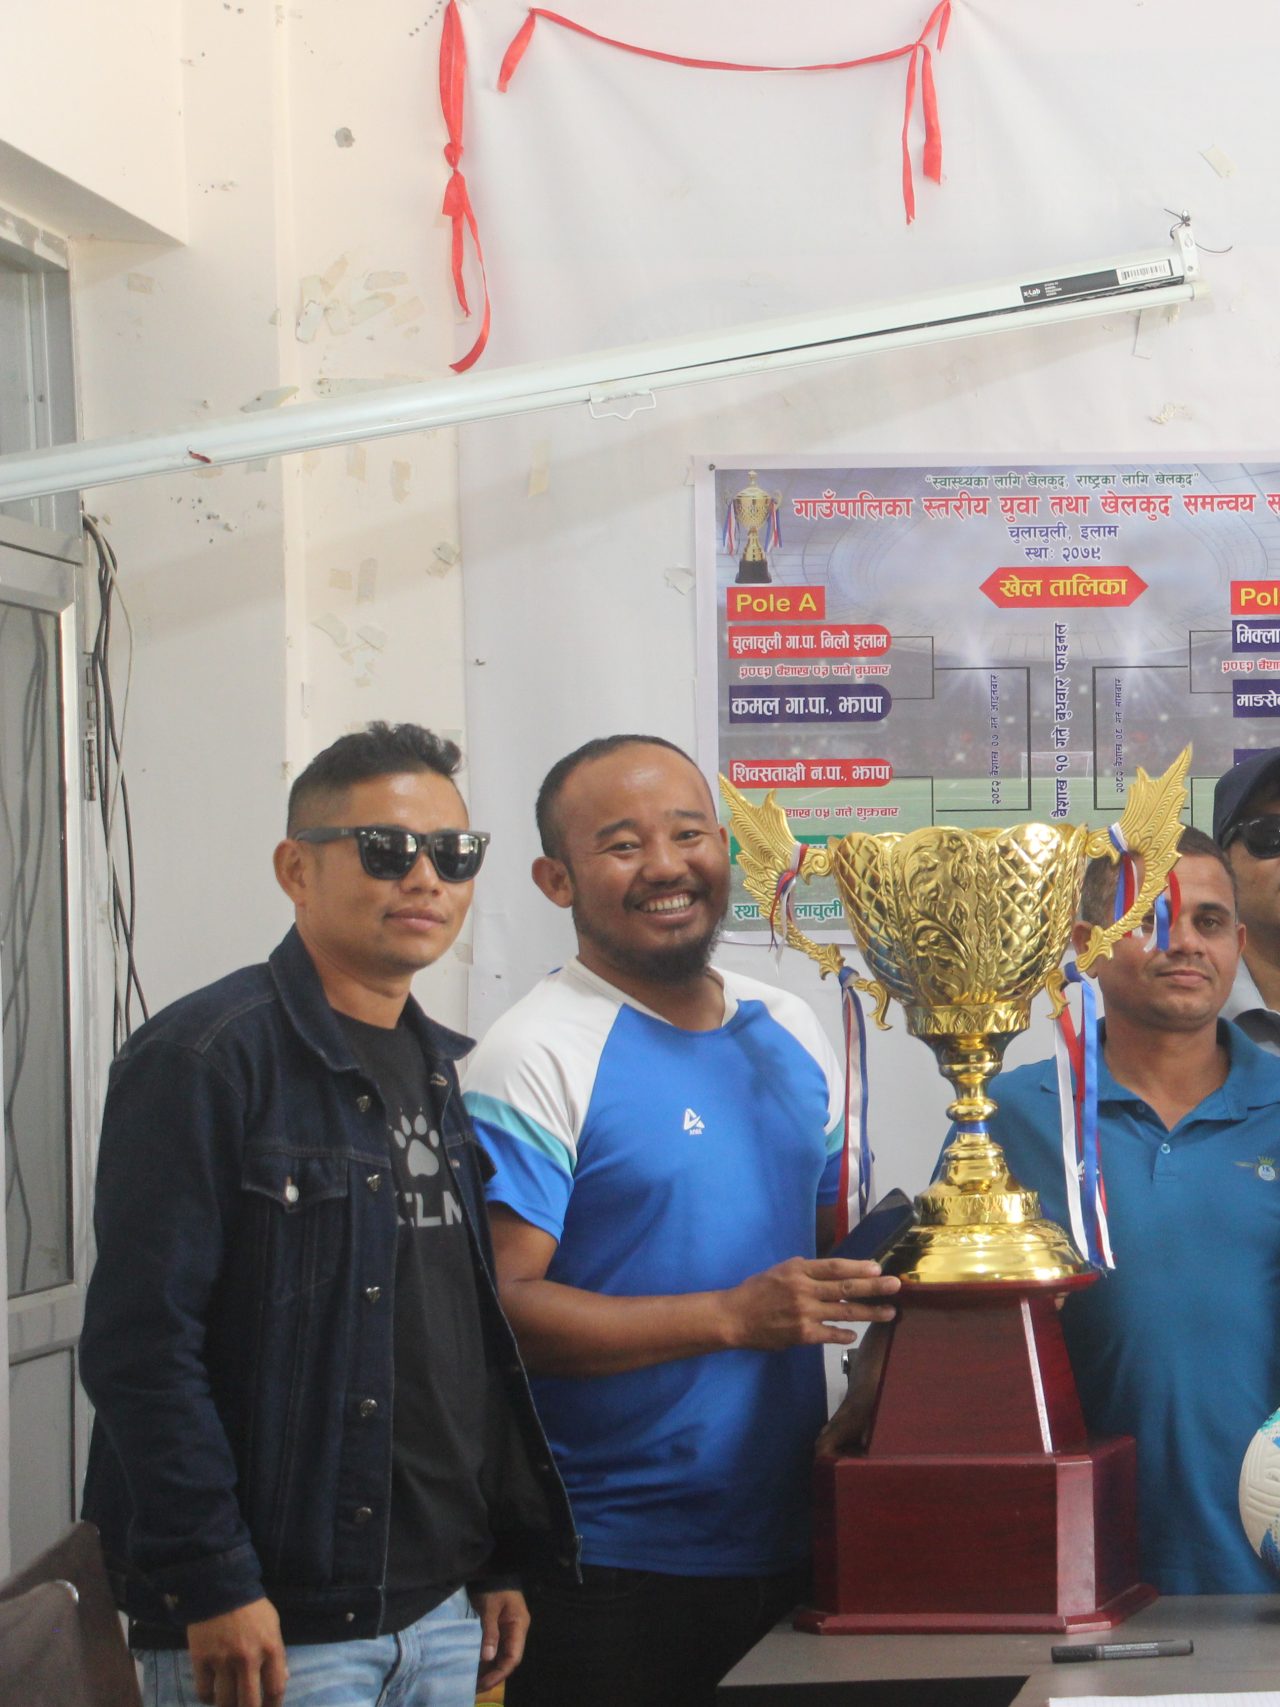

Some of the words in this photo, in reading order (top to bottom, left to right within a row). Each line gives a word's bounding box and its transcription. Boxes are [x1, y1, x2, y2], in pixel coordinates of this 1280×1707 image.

[995, 472, 1021, 488] लागि
[1122, 471, 1149, 487] लागि
[793, 489, 913, 519] गाउँपालिका
[923, 491, 990, 520] स्तरीय
[1000, 496, 1039, 522] युवा
[1050, 495, 1089, 517] तथा
[1101, 491, 1172, 521] खेलकुद
[1183, 494, 1257, 513] समन्वय
[1080, 524, 1119, 541] इलाम
[1063, 546, 1102, 561] २०७९
[1000, 574, 1042, 598] खेल
[1050, 573, 1127, 597] तालिका
[736, 594, 791, 613] Pole
[799, 593, 817, 612] A
[733, 632, 782, 654] चुलाचुली
[854, 634, 887, 651] इलाम
[1054, 623, 1067, 671] फाइनल
[732, 696, 781, 716] कमल
[839, 696, 884, 715] झापा
[1052, 726, 1069, 747] गते
[852, 765, 891, 781] झापा
